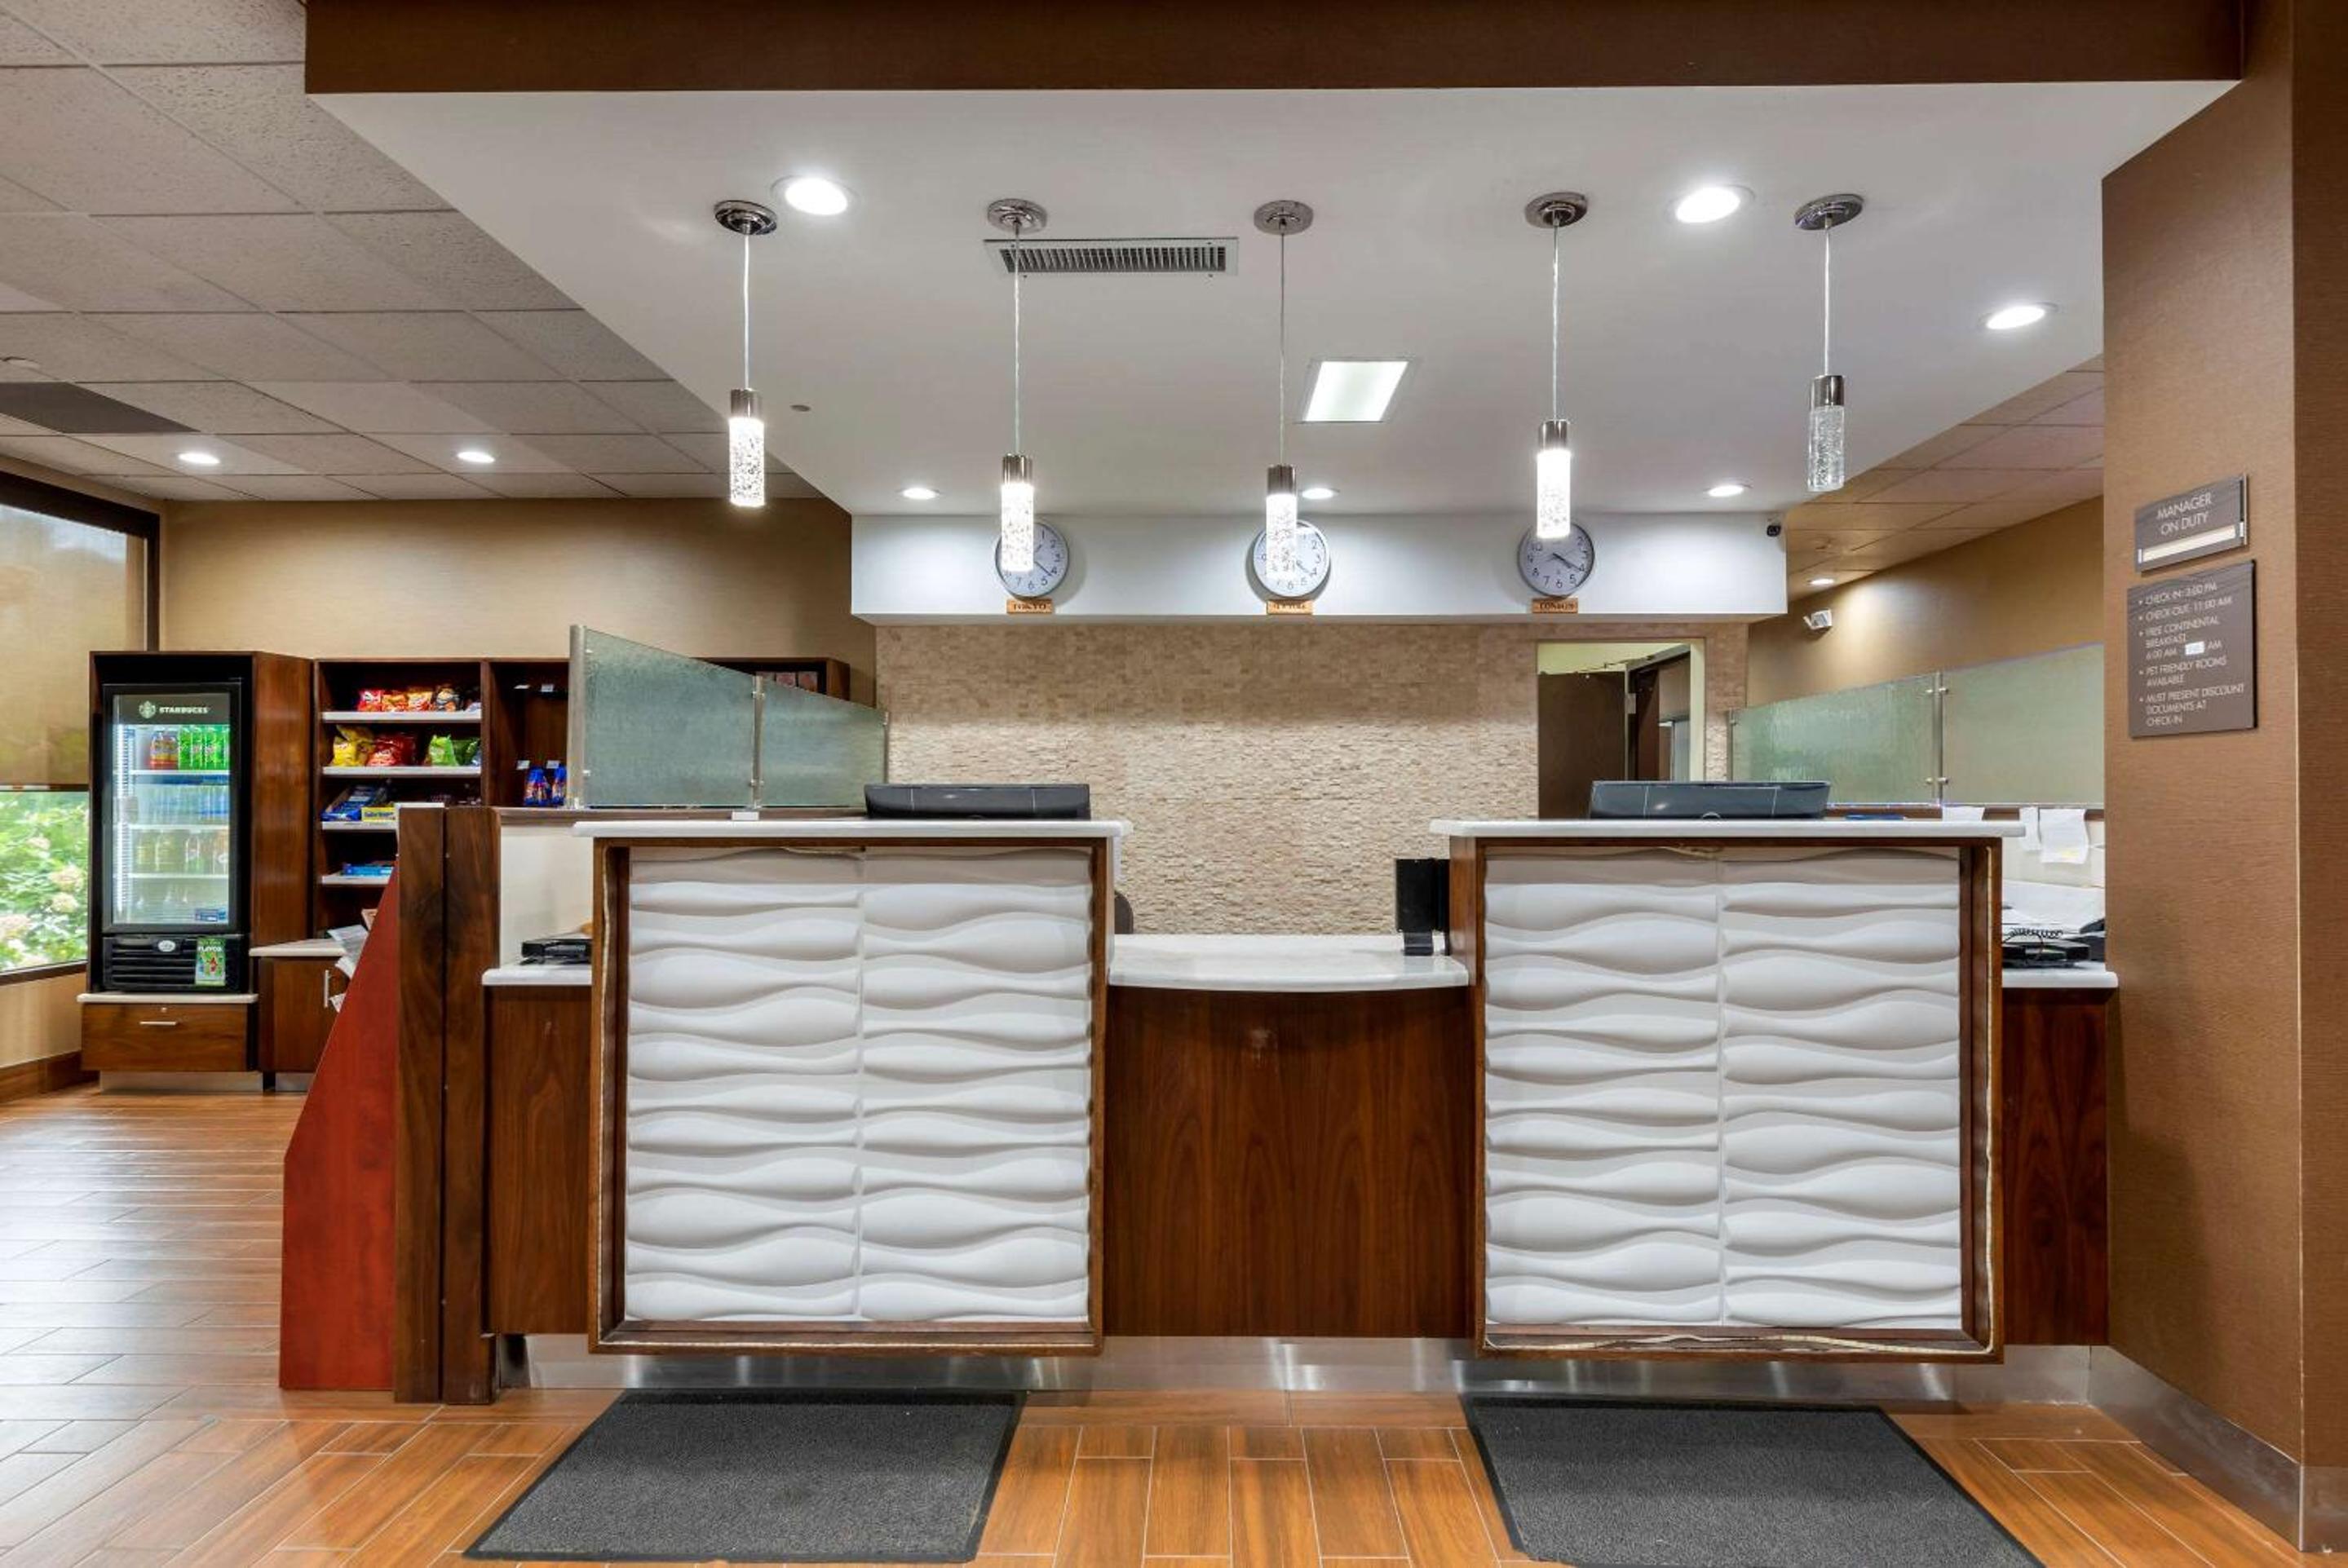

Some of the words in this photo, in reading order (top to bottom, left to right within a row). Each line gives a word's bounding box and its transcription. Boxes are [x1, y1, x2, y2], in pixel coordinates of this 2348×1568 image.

[2156, 492, 2213, 519] MANAGER
[2160, 520, 2179, 536] ON
[2181, 510, 2209, 530] DUTY
[2218, 595, 2233, 606] AM
[2146, 625, 2163, 637] FREE
[2164, 616, 2219, 634] CONTINENTAL
[2145, 634, 2187, 648] BREAKFAST
[2164, 647, 2178, 657] AM
[2208, 640, 2222, 650] AM
[2146, 665, 2159, 676] PET
[2160, 660, 2194, 674] FRIENDLY
[2195, 656, 2227, 669] ROOMS
[2146, 674, 2185, 687] AVAILABLE
[2146, 691, 2166, 704] MUST
[2167, 687, 2200, 700] PRESENT
[2202, 683, 2244, 697] DISCOUNT
[158, 706, 209, 714] STARBUCKS
[2146, 701, 2194, 715] DOCUMENTS
[2195, 699, 2207, 710] AT
